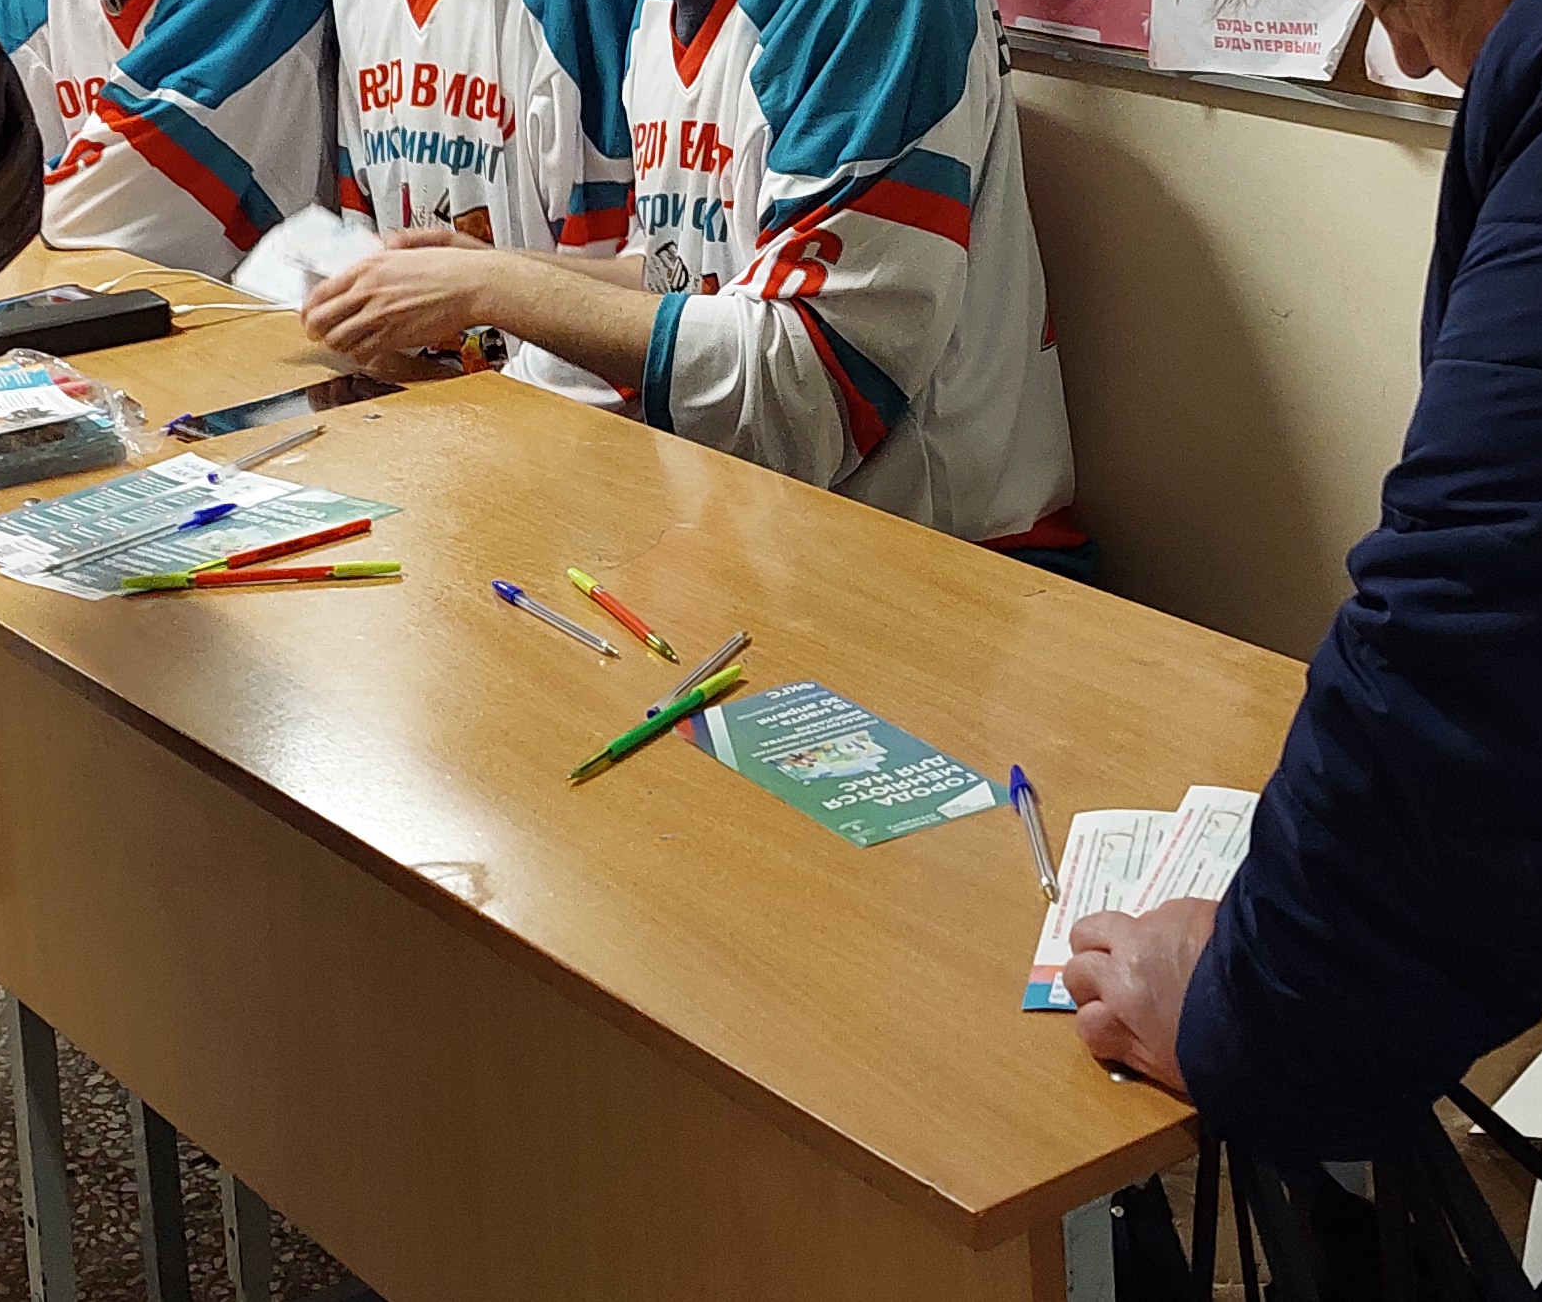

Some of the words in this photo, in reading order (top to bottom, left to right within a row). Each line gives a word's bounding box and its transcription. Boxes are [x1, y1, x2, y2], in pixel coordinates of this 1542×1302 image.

[1216, 18, 1252, 34] БУДЬ
[1254, 20, 1265, 34] С
[1266, 21, 1318, 36] НАМИ!
[1214, 36, 1251, 53] БУДЬ
[1252, 38, 1322, 55] ПЕРВЫМ!
[761, 227, 844, 299] 6
[765, 682, 816, 700] ФКГС
[755, 701, 818, 725] апреля
[893, 753, 948, 776] ДЛЯ
[821, 763, 965, 810] МЕНЯЮТСЯ
[837, 771, 893, 793] НАС
[872, 772, 979, 807] ГОРОДА
